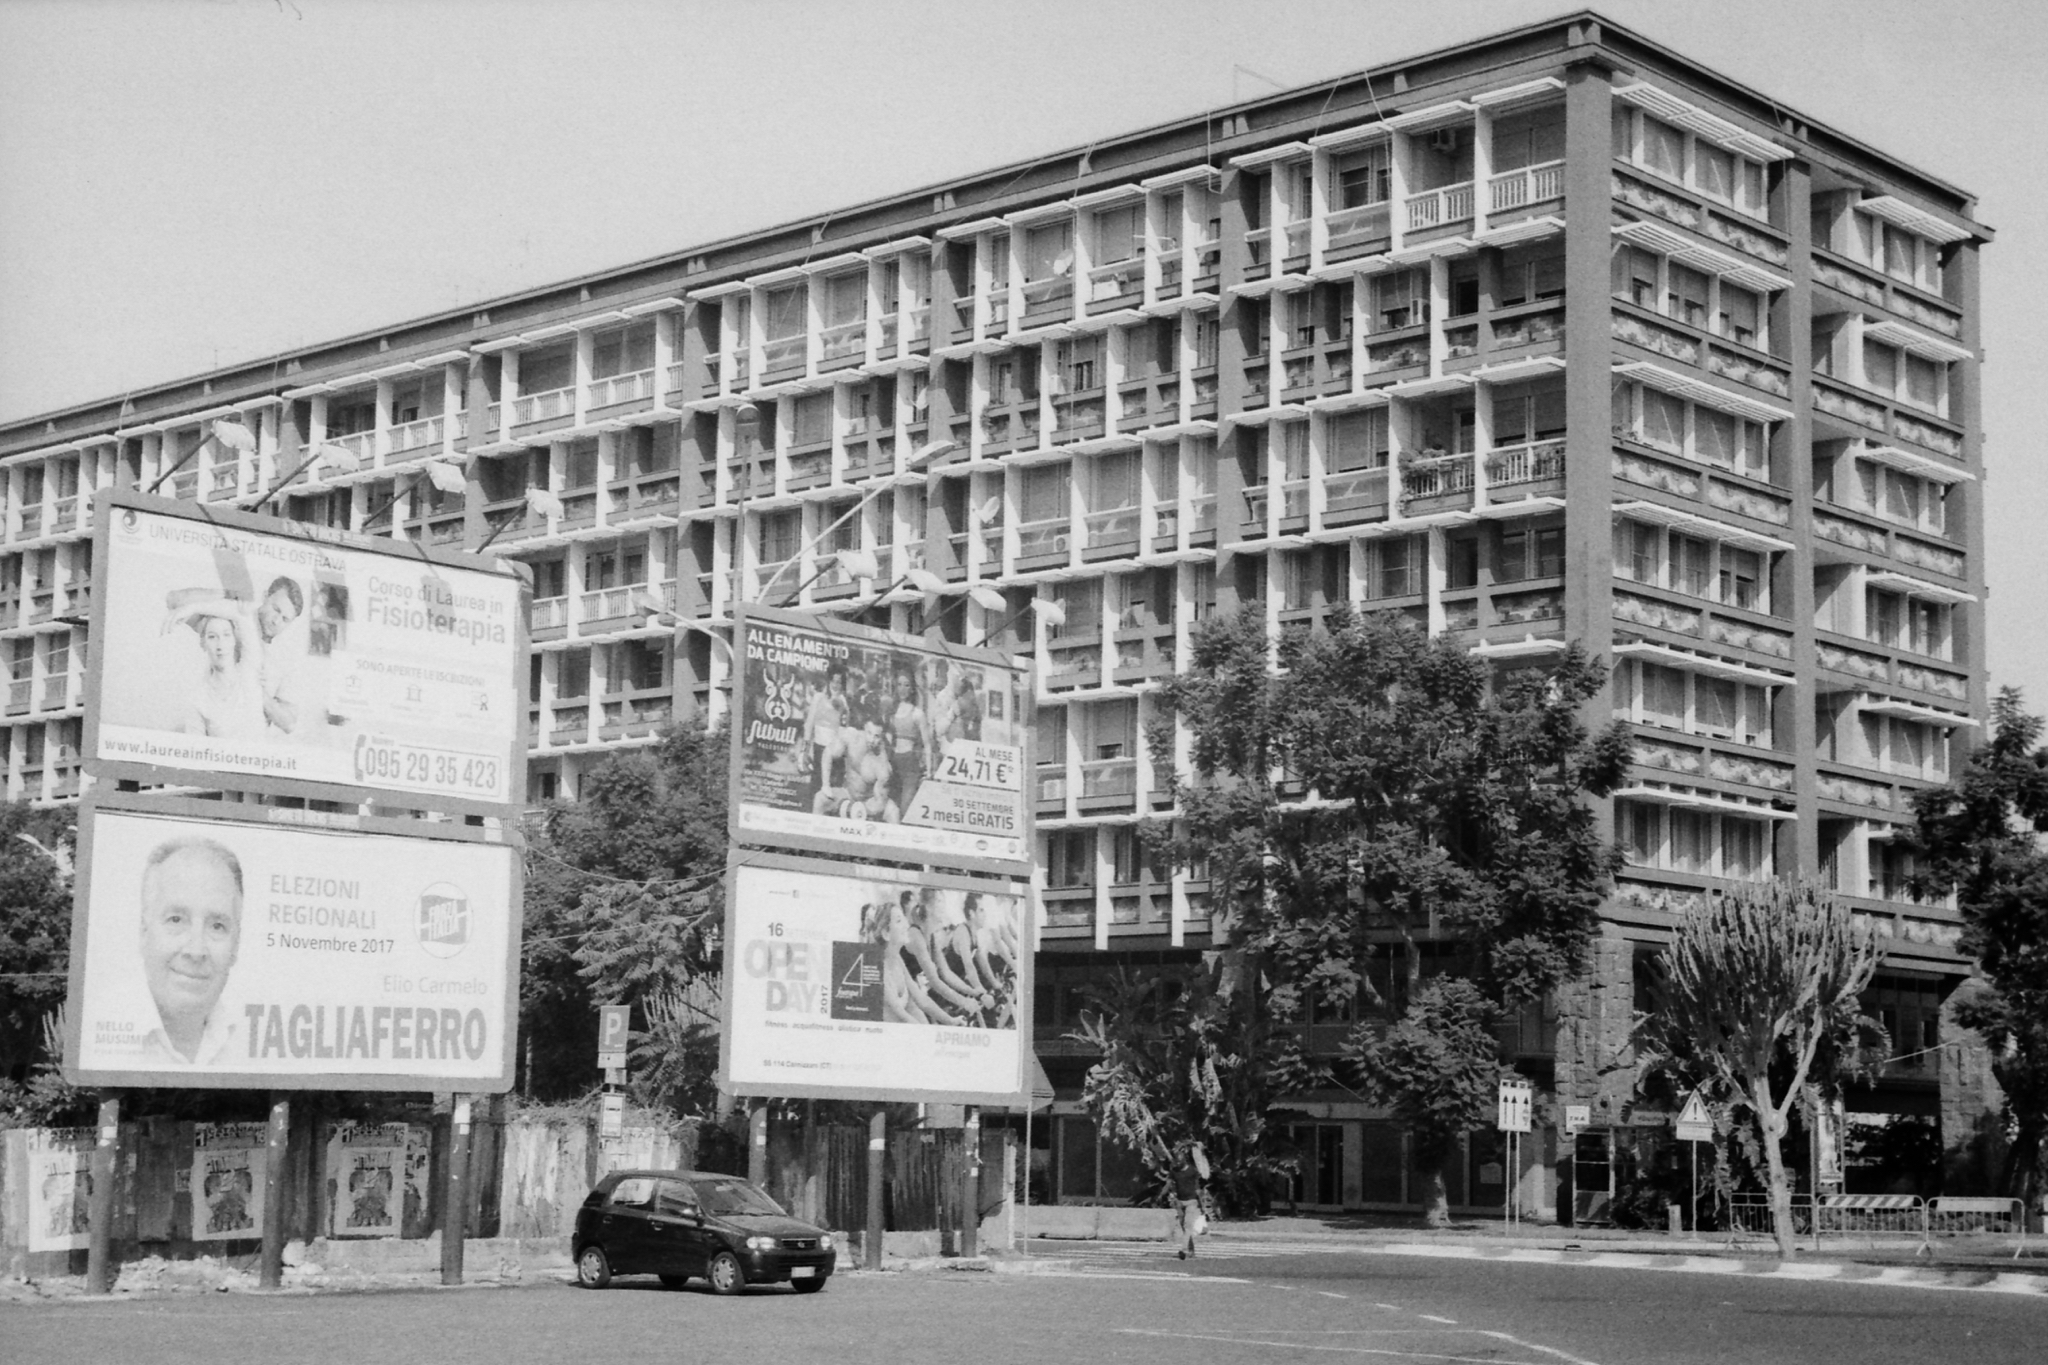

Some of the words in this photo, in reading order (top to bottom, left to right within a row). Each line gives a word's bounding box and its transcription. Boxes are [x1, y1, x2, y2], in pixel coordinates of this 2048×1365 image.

[232, 539, 285, 561] STATALE
[290, 549, 346, 570] OSTRAVA
[369, 576, 413, 598] Corso
[418, 585, 431, 602] di
[436, 587, 485, 611] Laurea
[489, 596, 503, 613] in
[368, 596, 505, 645] Fisioterapia
[748, 629, 849, 659] ALLENAMENTO
[356, 659, 384, 672] SONO
[387, 665, 421, 678] APERTE
[747, 644, 764, 660] DA
[766, 648, 829, 672] CAMPIONI?
[105, 740, 296, 770] www.laureainfisioterapia.it
[366, 747, 400, 779] 095
[407, 753, 429, 782] 29
[435, 755, 457, 785] 35
[463, 759, 496, 789] 423
[975, 747, 986, 757] AL
[989, 749, 1013, 762] MESE
[947, 756, 990, 781] 24,71
[922, 805, 929, 819] 2
[934, 810, 964, 823] mesi
[968, 812, 1014, 830] GRATIS
[953, 798, 964, 808] 30
[966, 800, 1014, 815] SETTEMBRE
[840, 826, 862, 836] MAX
[270, 874, 360, 900] ELEZIONI
[269, 903, 377, 930] REGIONALI
[768, 922, 784, 936] 16
[267, 933, 275, 947] 5
[280, 933, 357, 952] Novembre
[361, 938, 395, 954] 2017
[744, 939, 831, 981] OPEN
[384, 975, 412, 992] Elio
[419, 977, 488, 995] Carmelo
[766, 980, 819, 1013] DAY
[820, 985, 829, 1014] 2017
[96, 1021, 135, 1032] NELLO
[245, 1003, 487, 1061] TAGLIAFERRO
[604, 1012, 621, 1045] P
[935, 1031, 991, 1047] APRIAMO
